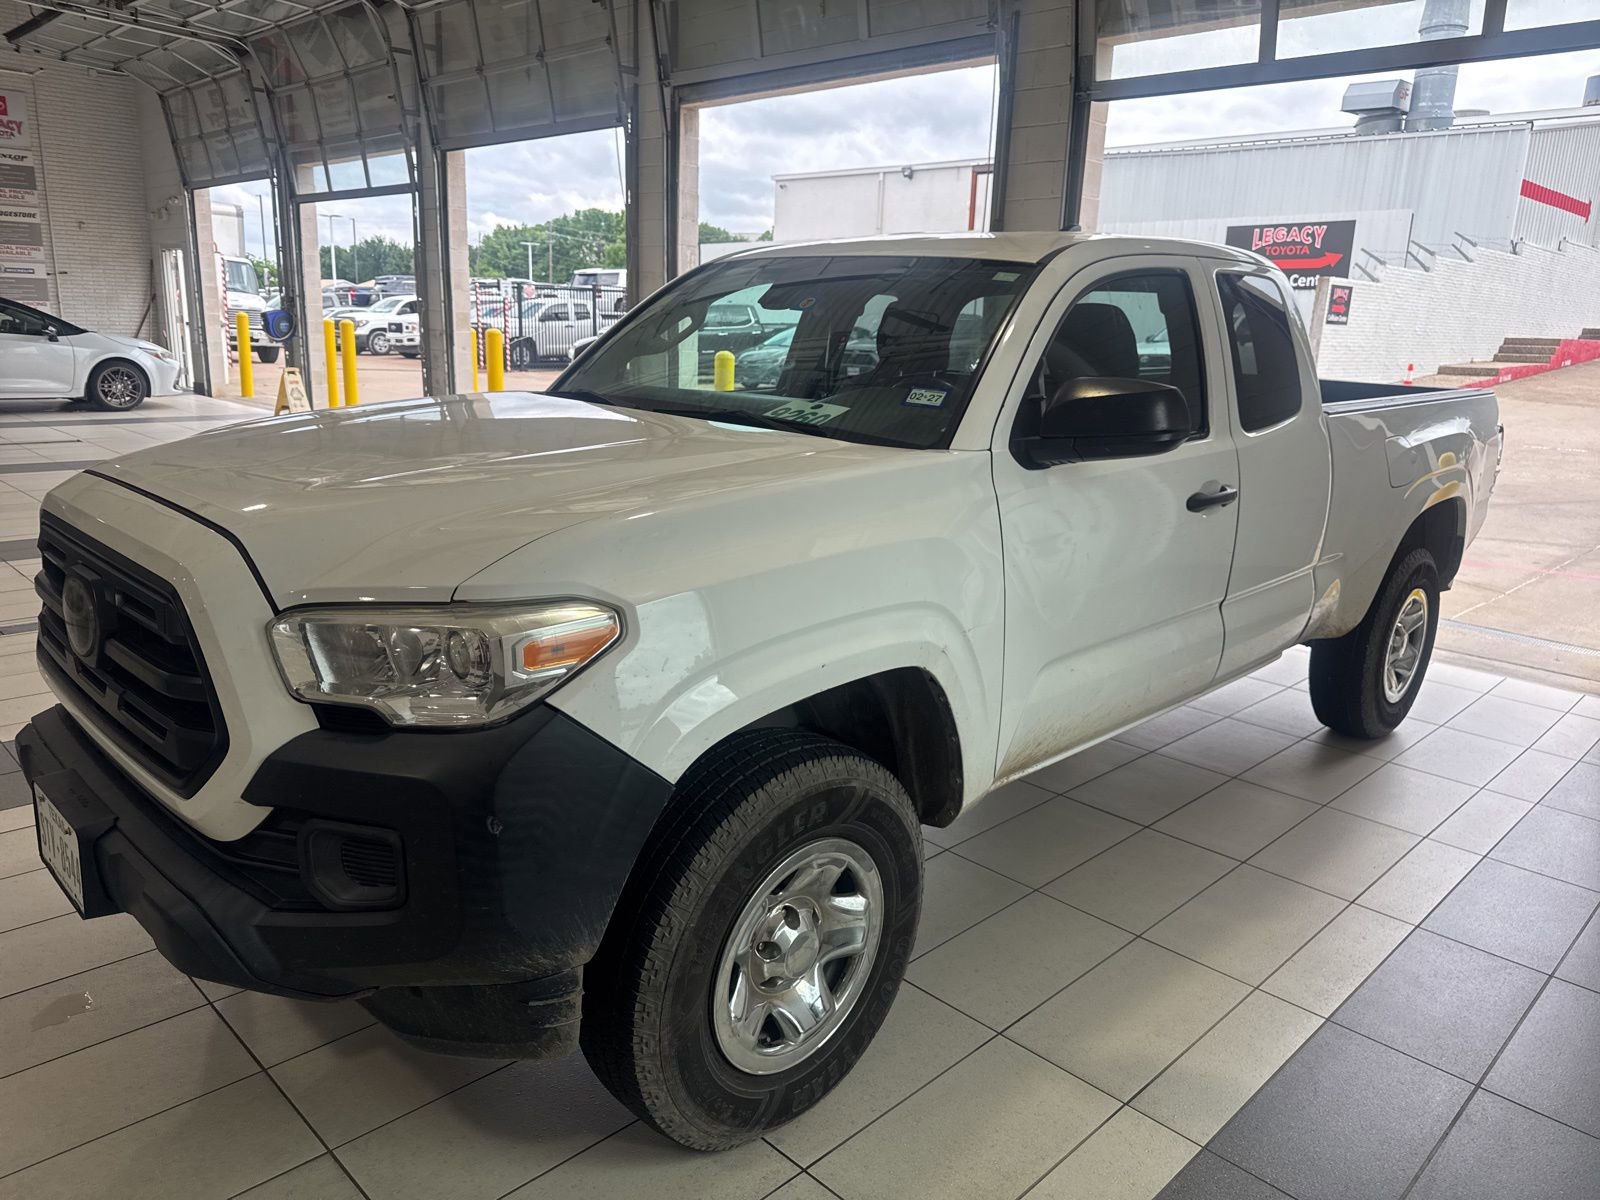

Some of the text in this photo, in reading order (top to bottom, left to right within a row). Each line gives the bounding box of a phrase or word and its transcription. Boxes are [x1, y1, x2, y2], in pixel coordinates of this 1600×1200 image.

[1252, 225, 1327, 250] LEGACY
[1265, 245, 1310, 256] TOYOTA
[1290, 274, 1319, 287] Cent
